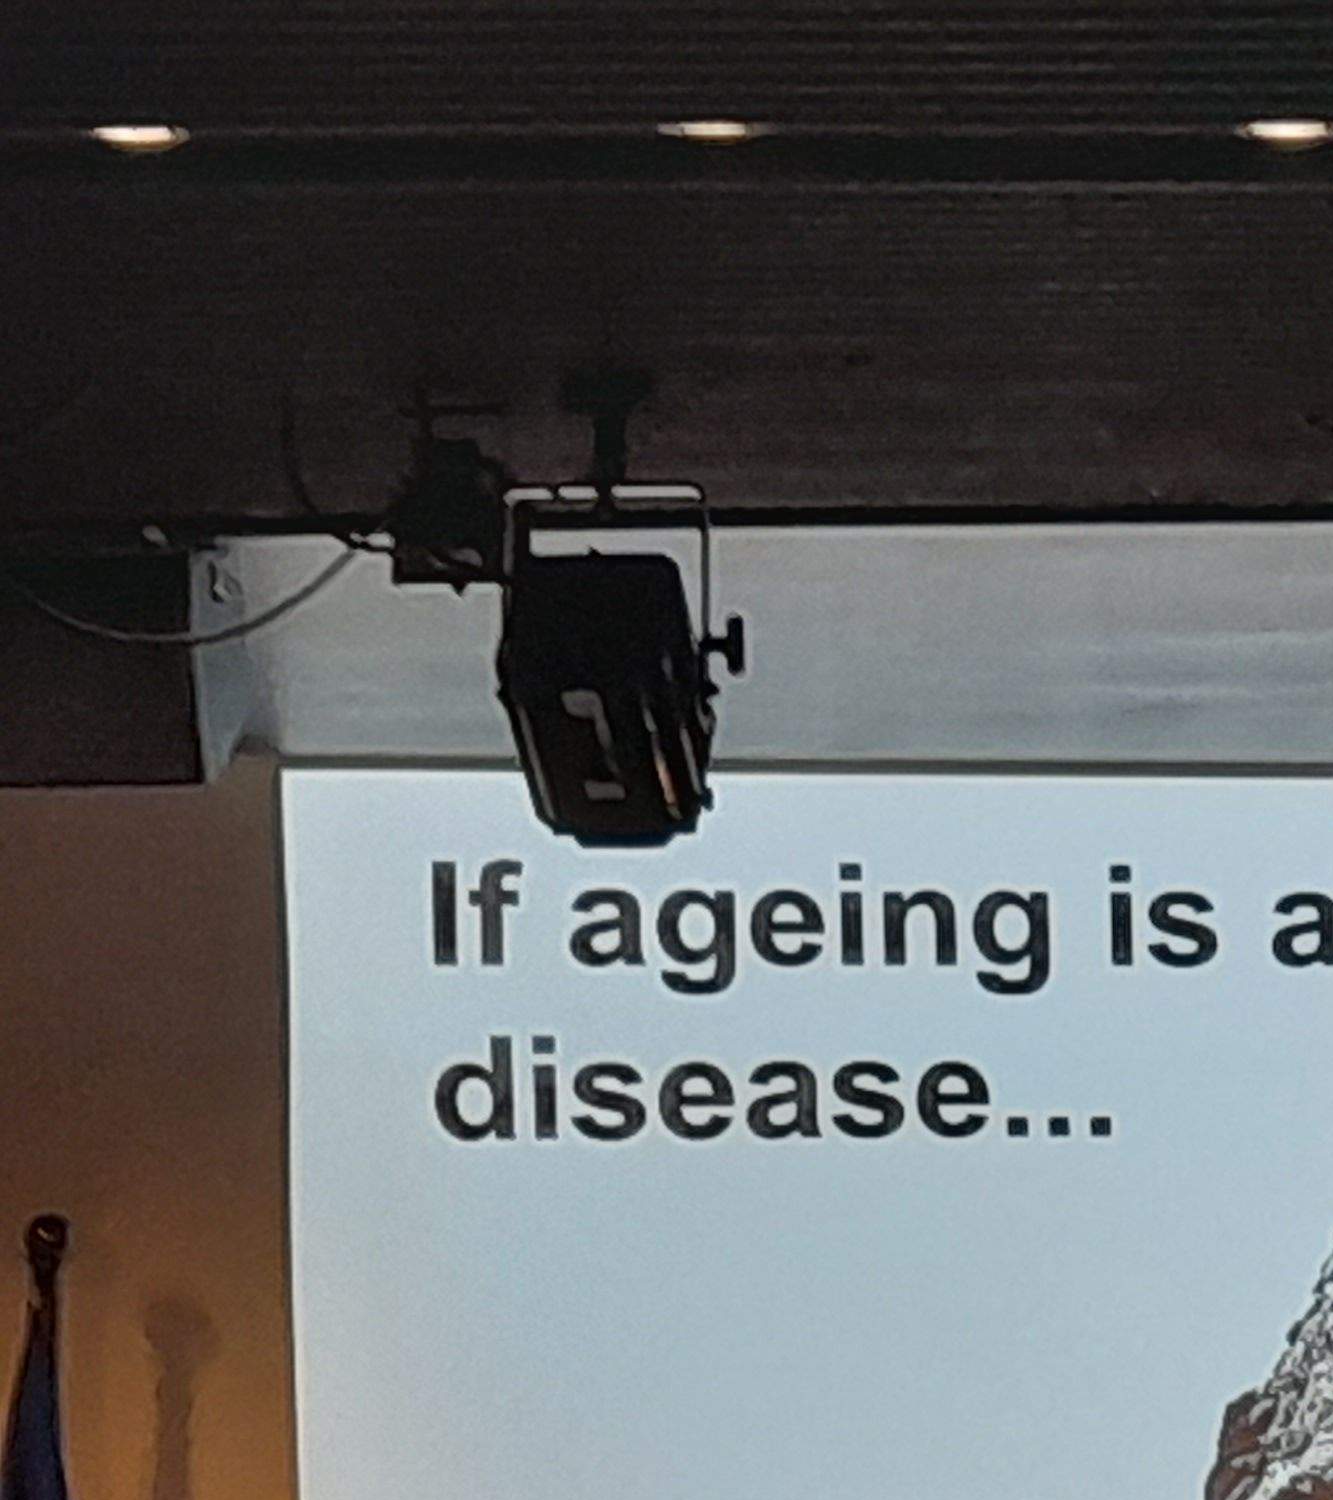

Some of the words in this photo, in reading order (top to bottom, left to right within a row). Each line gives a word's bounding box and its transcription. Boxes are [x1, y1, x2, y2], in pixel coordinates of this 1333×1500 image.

[432, 859, 522, 966] If
[569, 863, 1050, 995] ageing
[1109, 864, 1218, 968] is
[434, 1035, 1113, 1142] disease...
